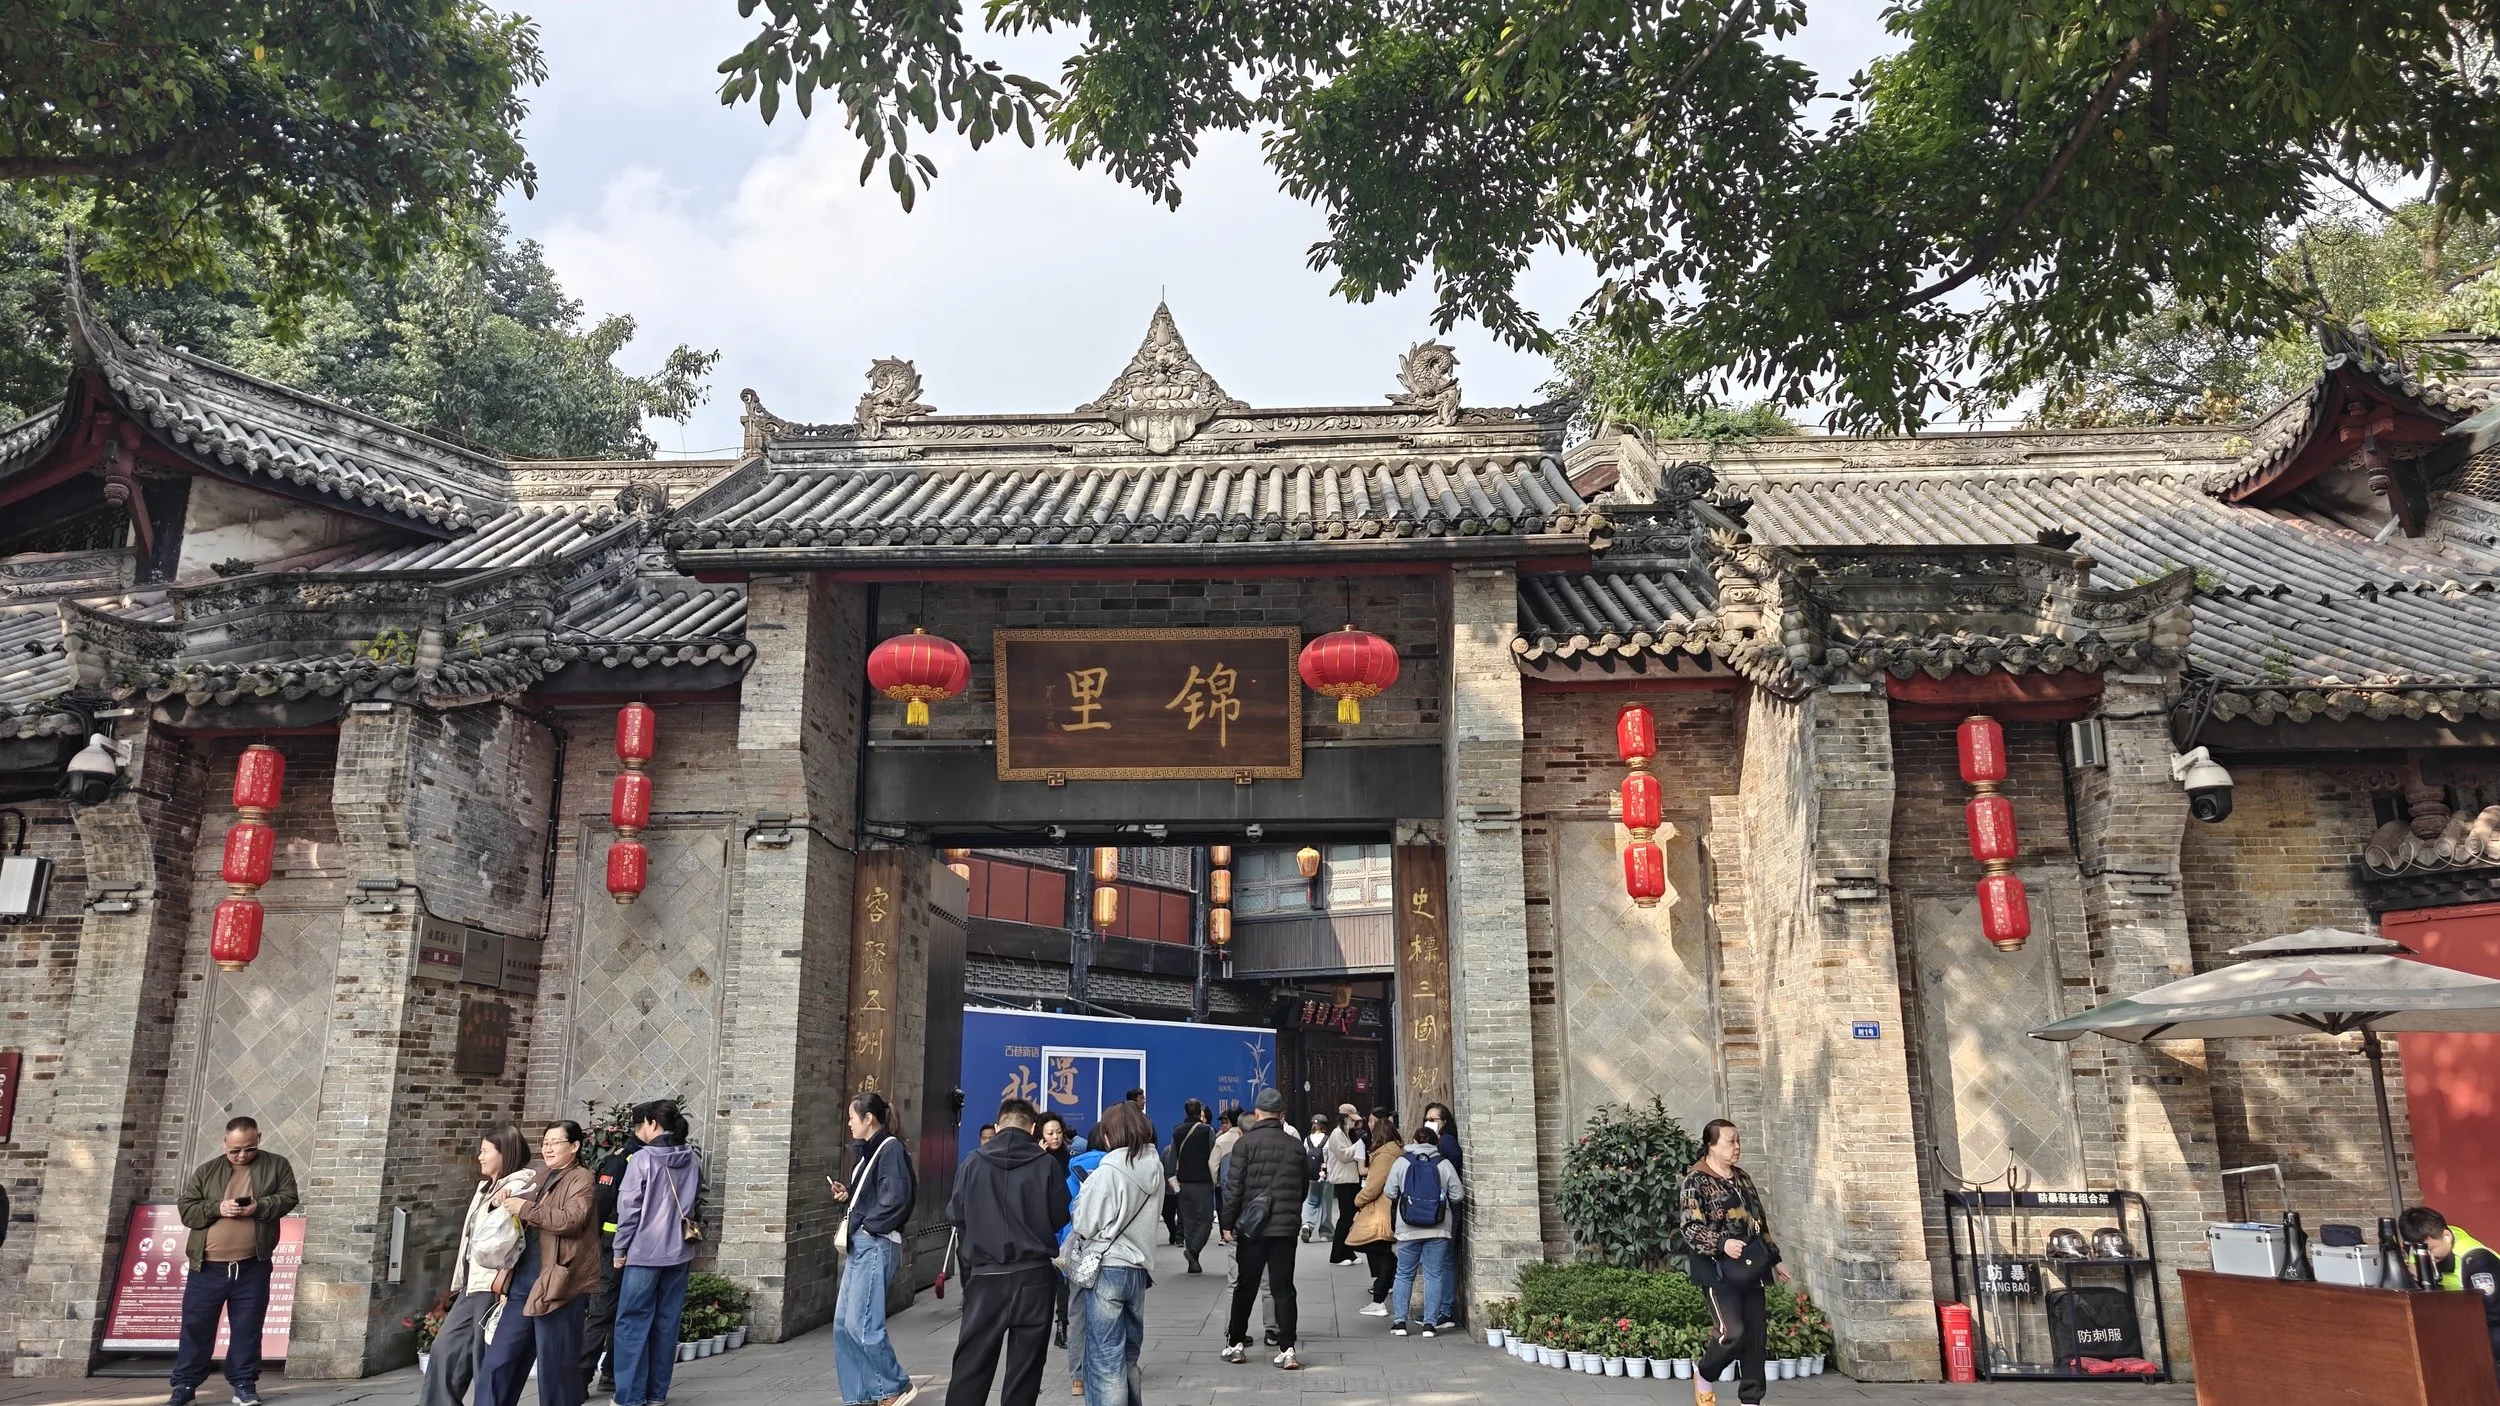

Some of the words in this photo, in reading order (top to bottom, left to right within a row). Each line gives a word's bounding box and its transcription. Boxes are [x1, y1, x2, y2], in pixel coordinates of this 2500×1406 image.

[2164, 992, 2446, 1016] Heineken
[2037, 1192, 2109, 1204] 防暴装备组合架
[1986, 1264, 2026, 1281] 防暴
[1985, 1281, 2010, 1292] FANG
[2011, 1282, 2030, 1292] BAO
[2077, 1328, 2123, 1344] 防刺服
